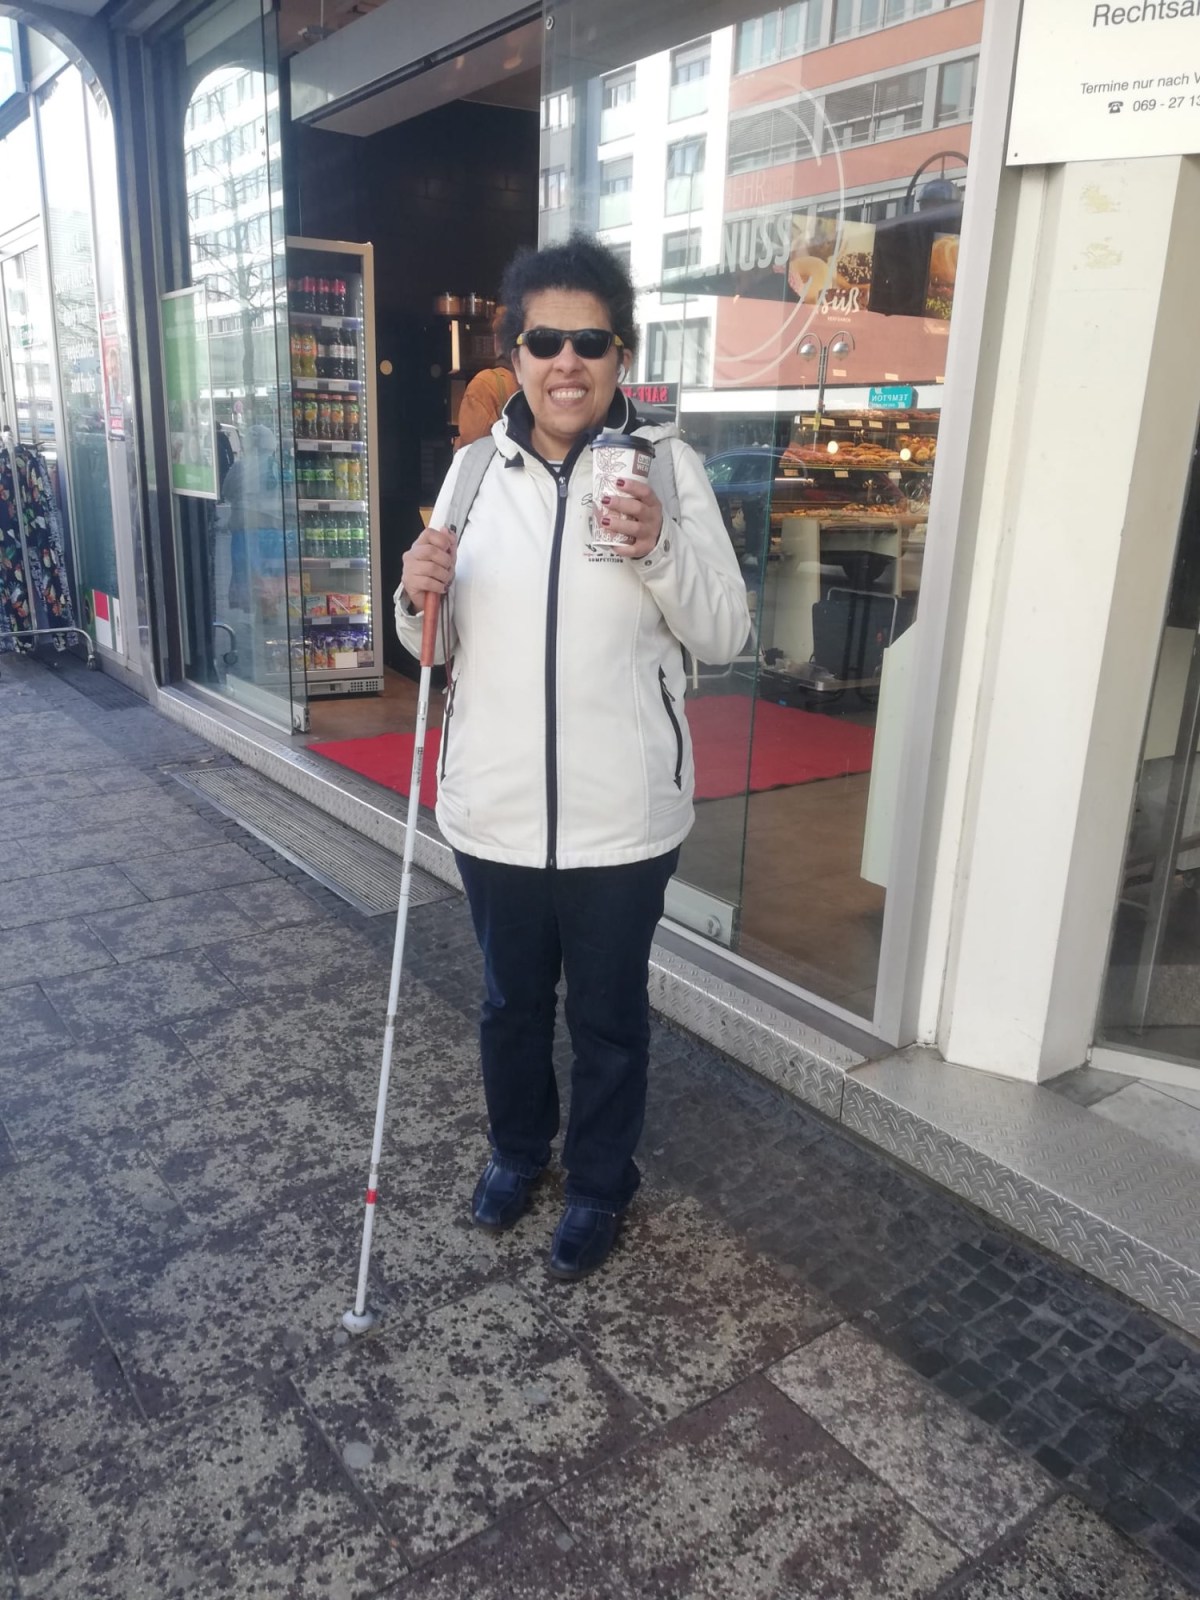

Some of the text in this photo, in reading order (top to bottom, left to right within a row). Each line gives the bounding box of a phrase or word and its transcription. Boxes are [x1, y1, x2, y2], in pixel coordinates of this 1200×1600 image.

[1093, 0, 1200, 27] Rechtsa
[1080, 80, 1129, 95] Termine
[1132, 78, 1155, 91] nur
[1157, 72, 1190, 88] nach
[1132, 98, 1157, 112] 069
[1168, 95, 1185, 109] 27
